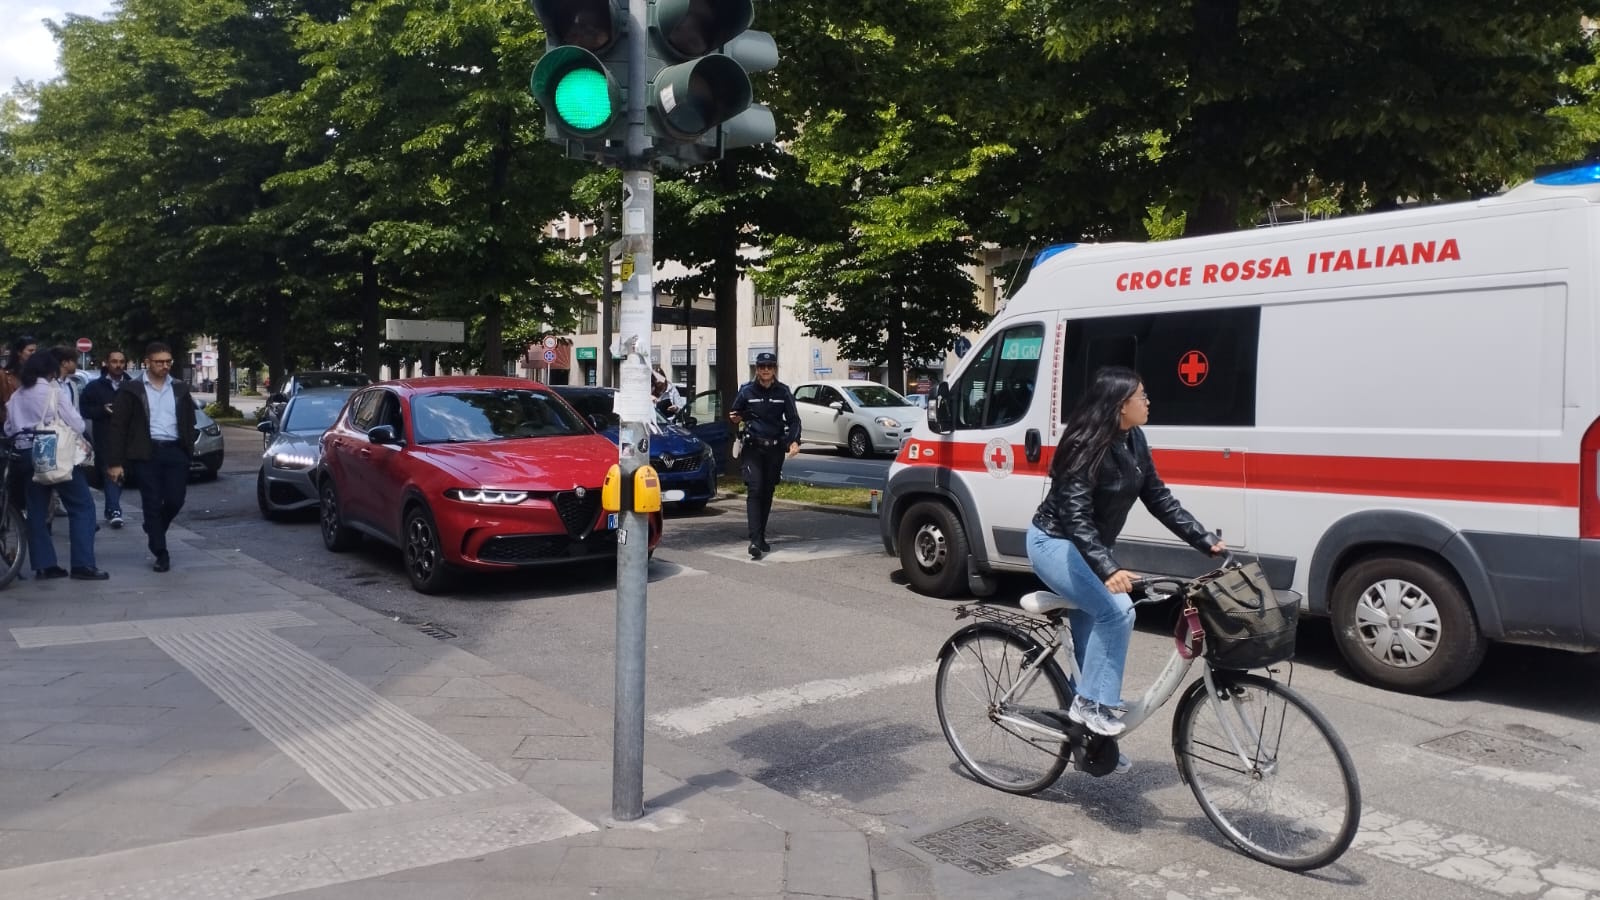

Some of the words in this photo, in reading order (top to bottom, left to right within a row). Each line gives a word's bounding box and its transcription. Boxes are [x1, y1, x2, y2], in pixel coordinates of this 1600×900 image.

[1116, 266, 1192, 292] CROCE
[1202, 256, 1292, 284] ROSSA
[1307, 238, 1461, 274] ITALIANA
